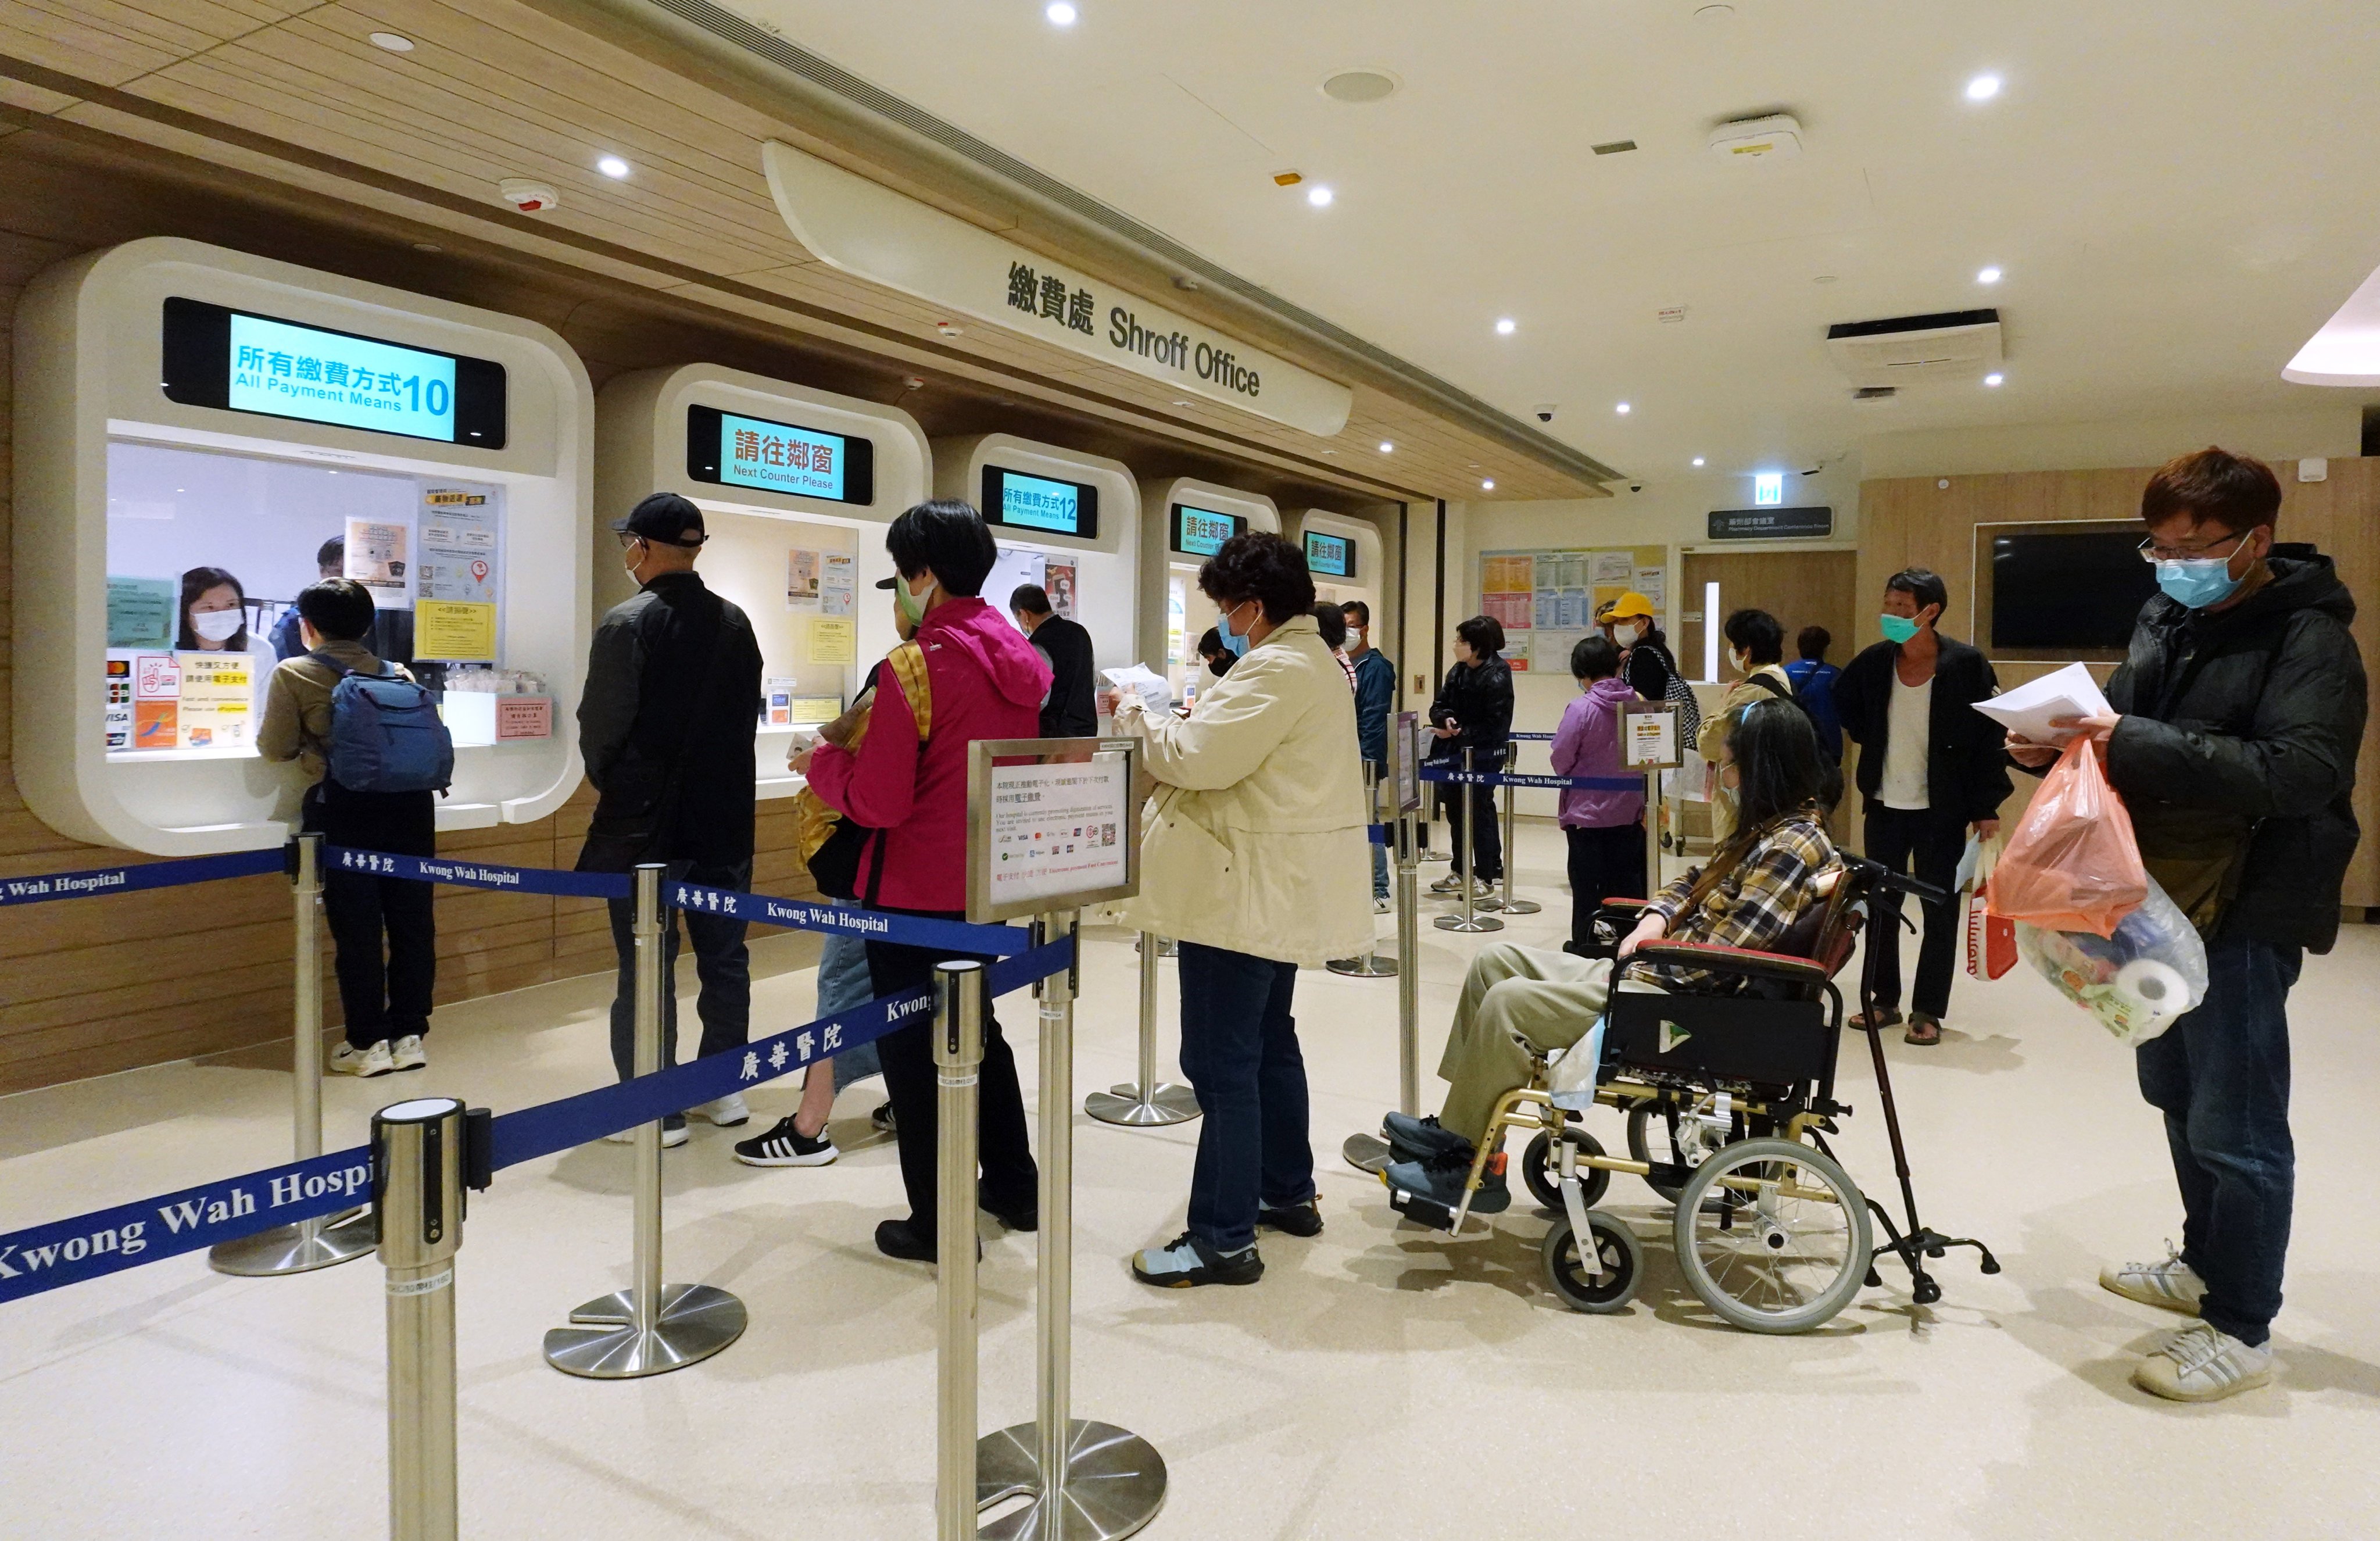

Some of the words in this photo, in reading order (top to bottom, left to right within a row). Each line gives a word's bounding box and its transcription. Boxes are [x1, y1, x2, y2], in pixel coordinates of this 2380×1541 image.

[1008, 260, 1094, 336] 繳費處
[1109, 306, 1189, 371] Shroff
[1195, 342, 1260, 397] Office
[238, 345, 401, 396] 所有繳費方式
[235, 373, 260, 388] All
[268, 378, 343, 403] Payment
[350, 392, 401, 412] Means
[403, 375, 449, 416] 10
[735, 428, 833, 475] 請往鄰窗
[734, 464, 757, 477] Next
[760, 469, 800, 484] Counter
[803, 475, 833, 489] Please
[1003, 487, 1060, 512] 所有繳費方式
[1003, 503, 1011, 512] All
[1013, 505, 1039, 517] Payment
[1040, 511, 1060, 520] Means
[1059, 497, 1076, 520] 12
[1187, 516, 1229, 541] 請往鄰窗
[185, 674, 248, 684] 請使用電子支付
[1502, 775, 1526, 785] Kwong
[1527, 776, 1542, 784] Wah
[1544, 777, 1573, 786] Hospital
[8, 880, 50, 896] Wah
[54, 871, 126, 892] Hospital
[419, 861, 453, 880] Kwong
[454, 866, 476, 879] Wah
[479, 869, 520, 886] Hospital
[677, 886, 737, 914] 廣華醫院
[767, 902, 806, 925] Kwong
[809, 908, 835, 925] Wah
[839, 912, 889, 933] Hospital
[740, 1023, 843, 1081] 廣華醫院
[158, 1188, 255, 1236] Wah
